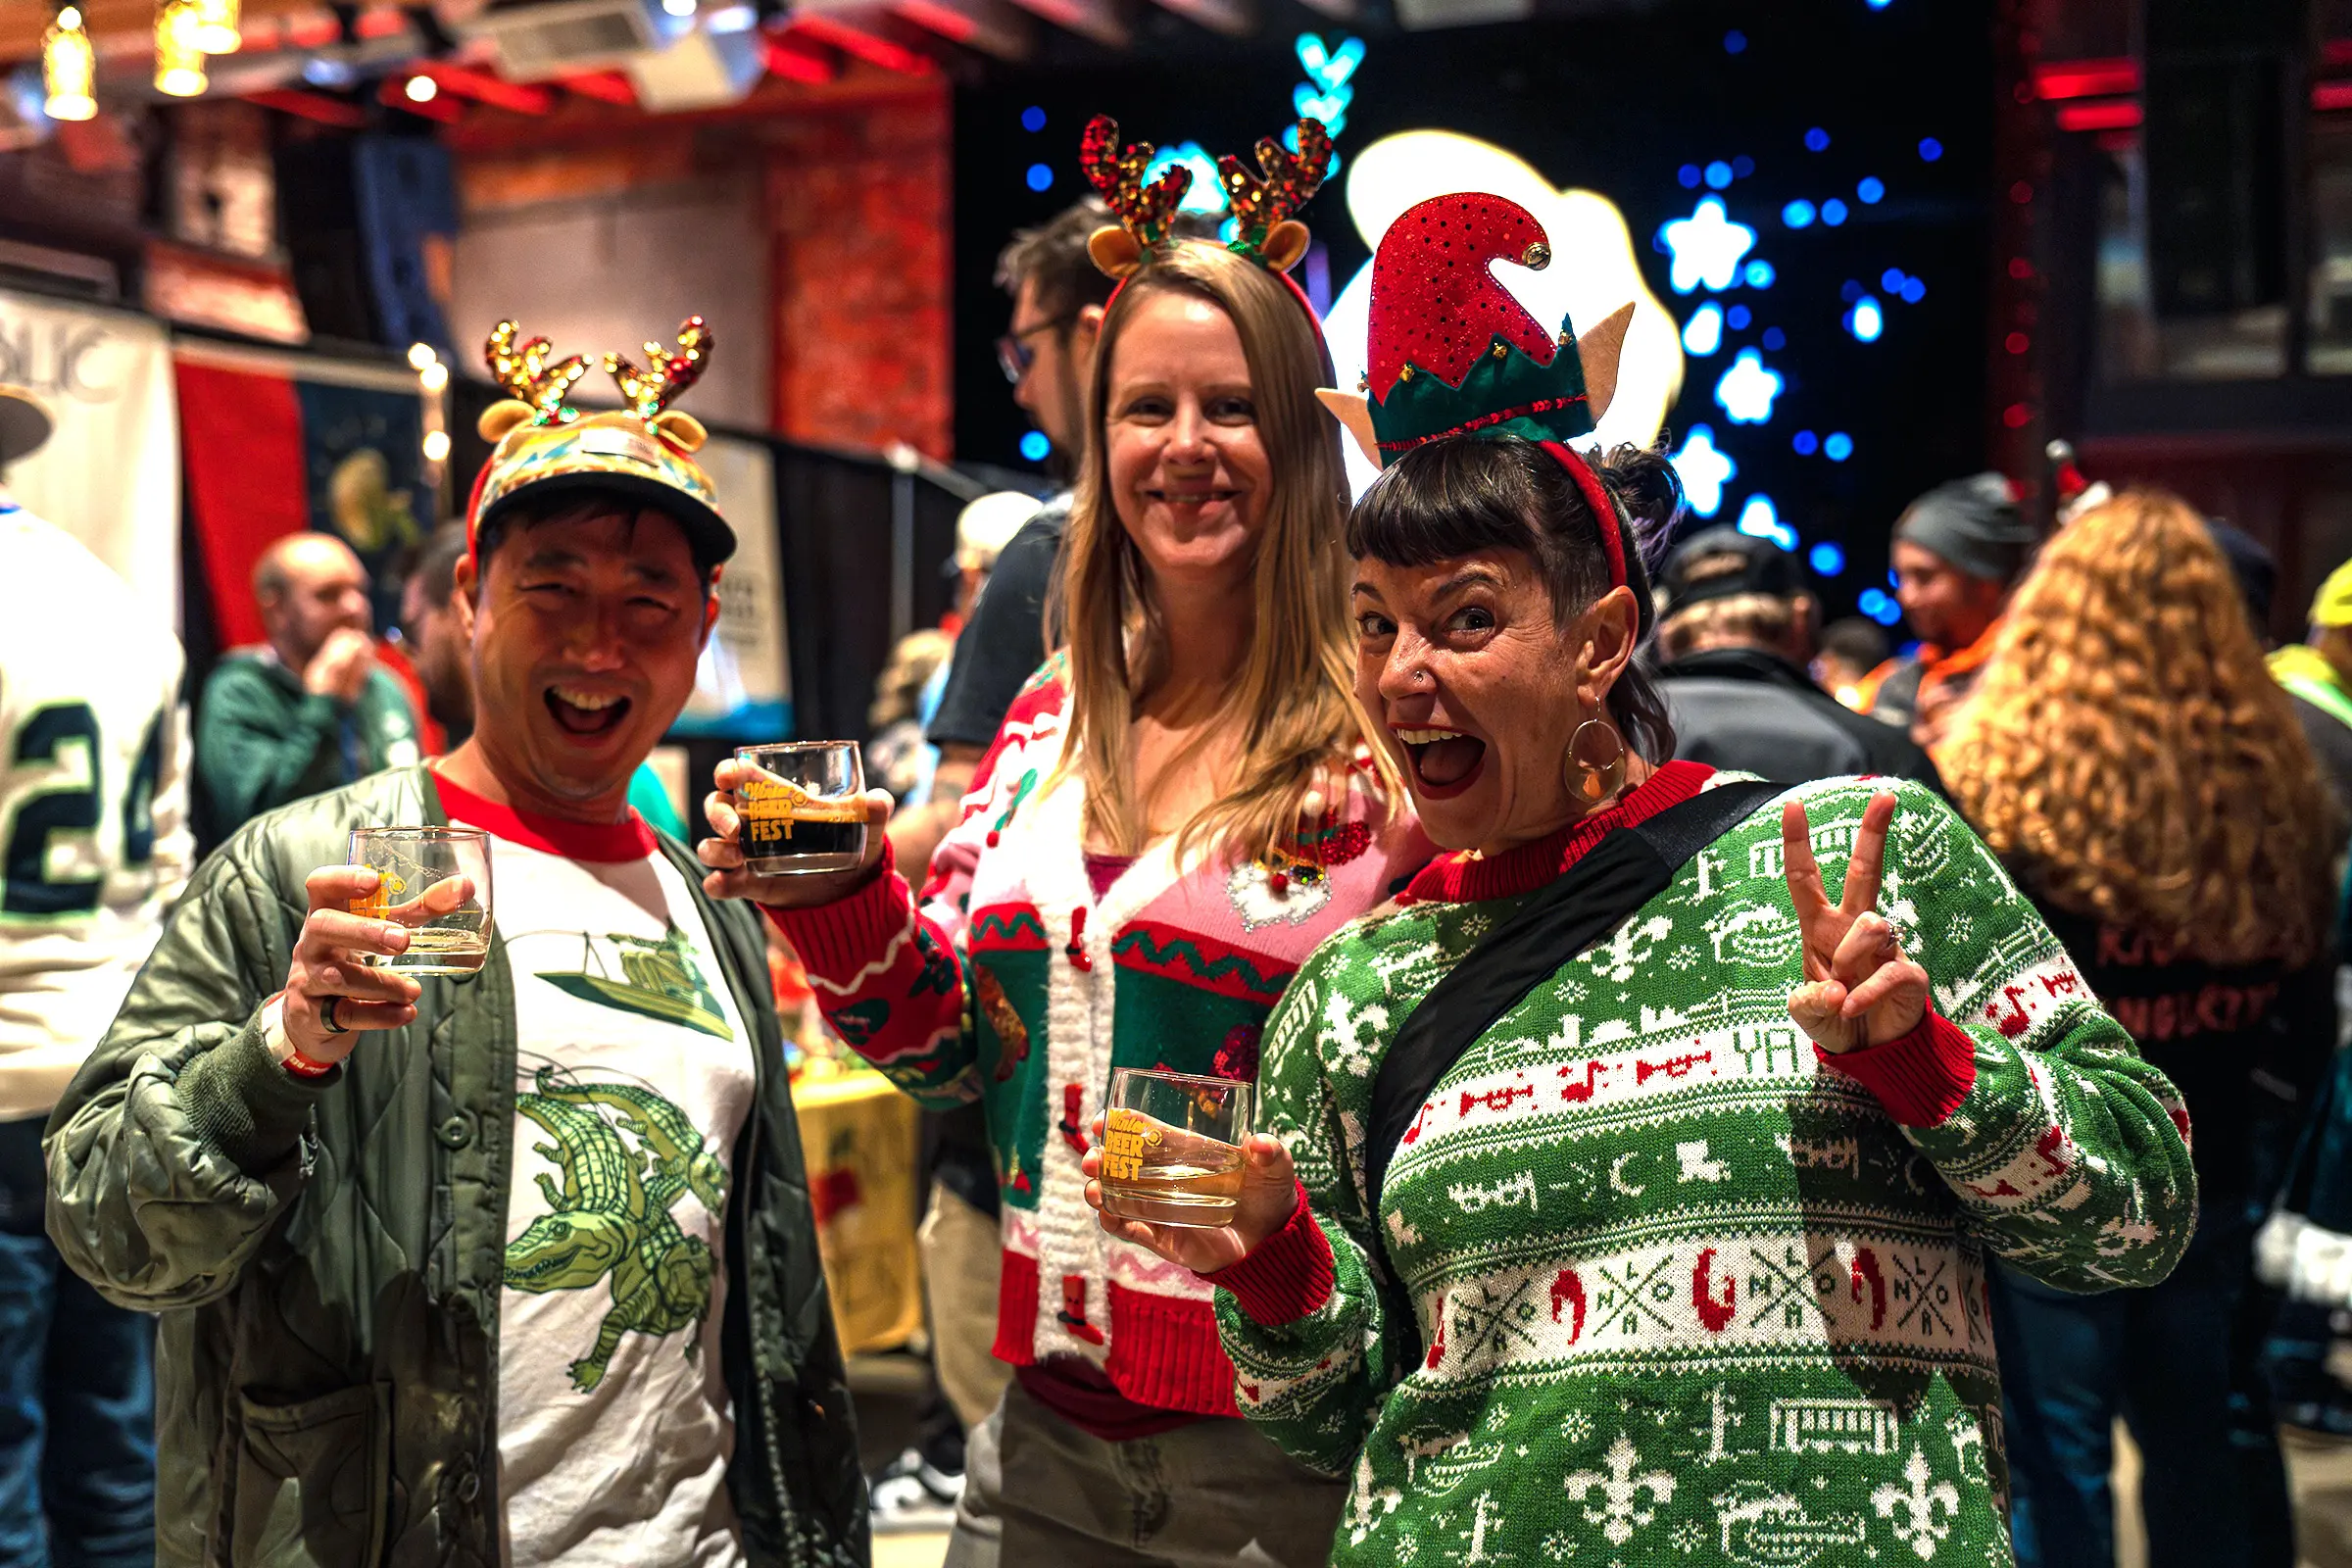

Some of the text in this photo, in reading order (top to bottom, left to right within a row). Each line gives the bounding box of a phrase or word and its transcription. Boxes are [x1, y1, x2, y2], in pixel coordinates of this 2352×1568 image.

[751, 820, 793, 842] FEST
[1105, 1131, 1144, 1157] BEER
[1104, 1155, 1143, 1181] FEST
